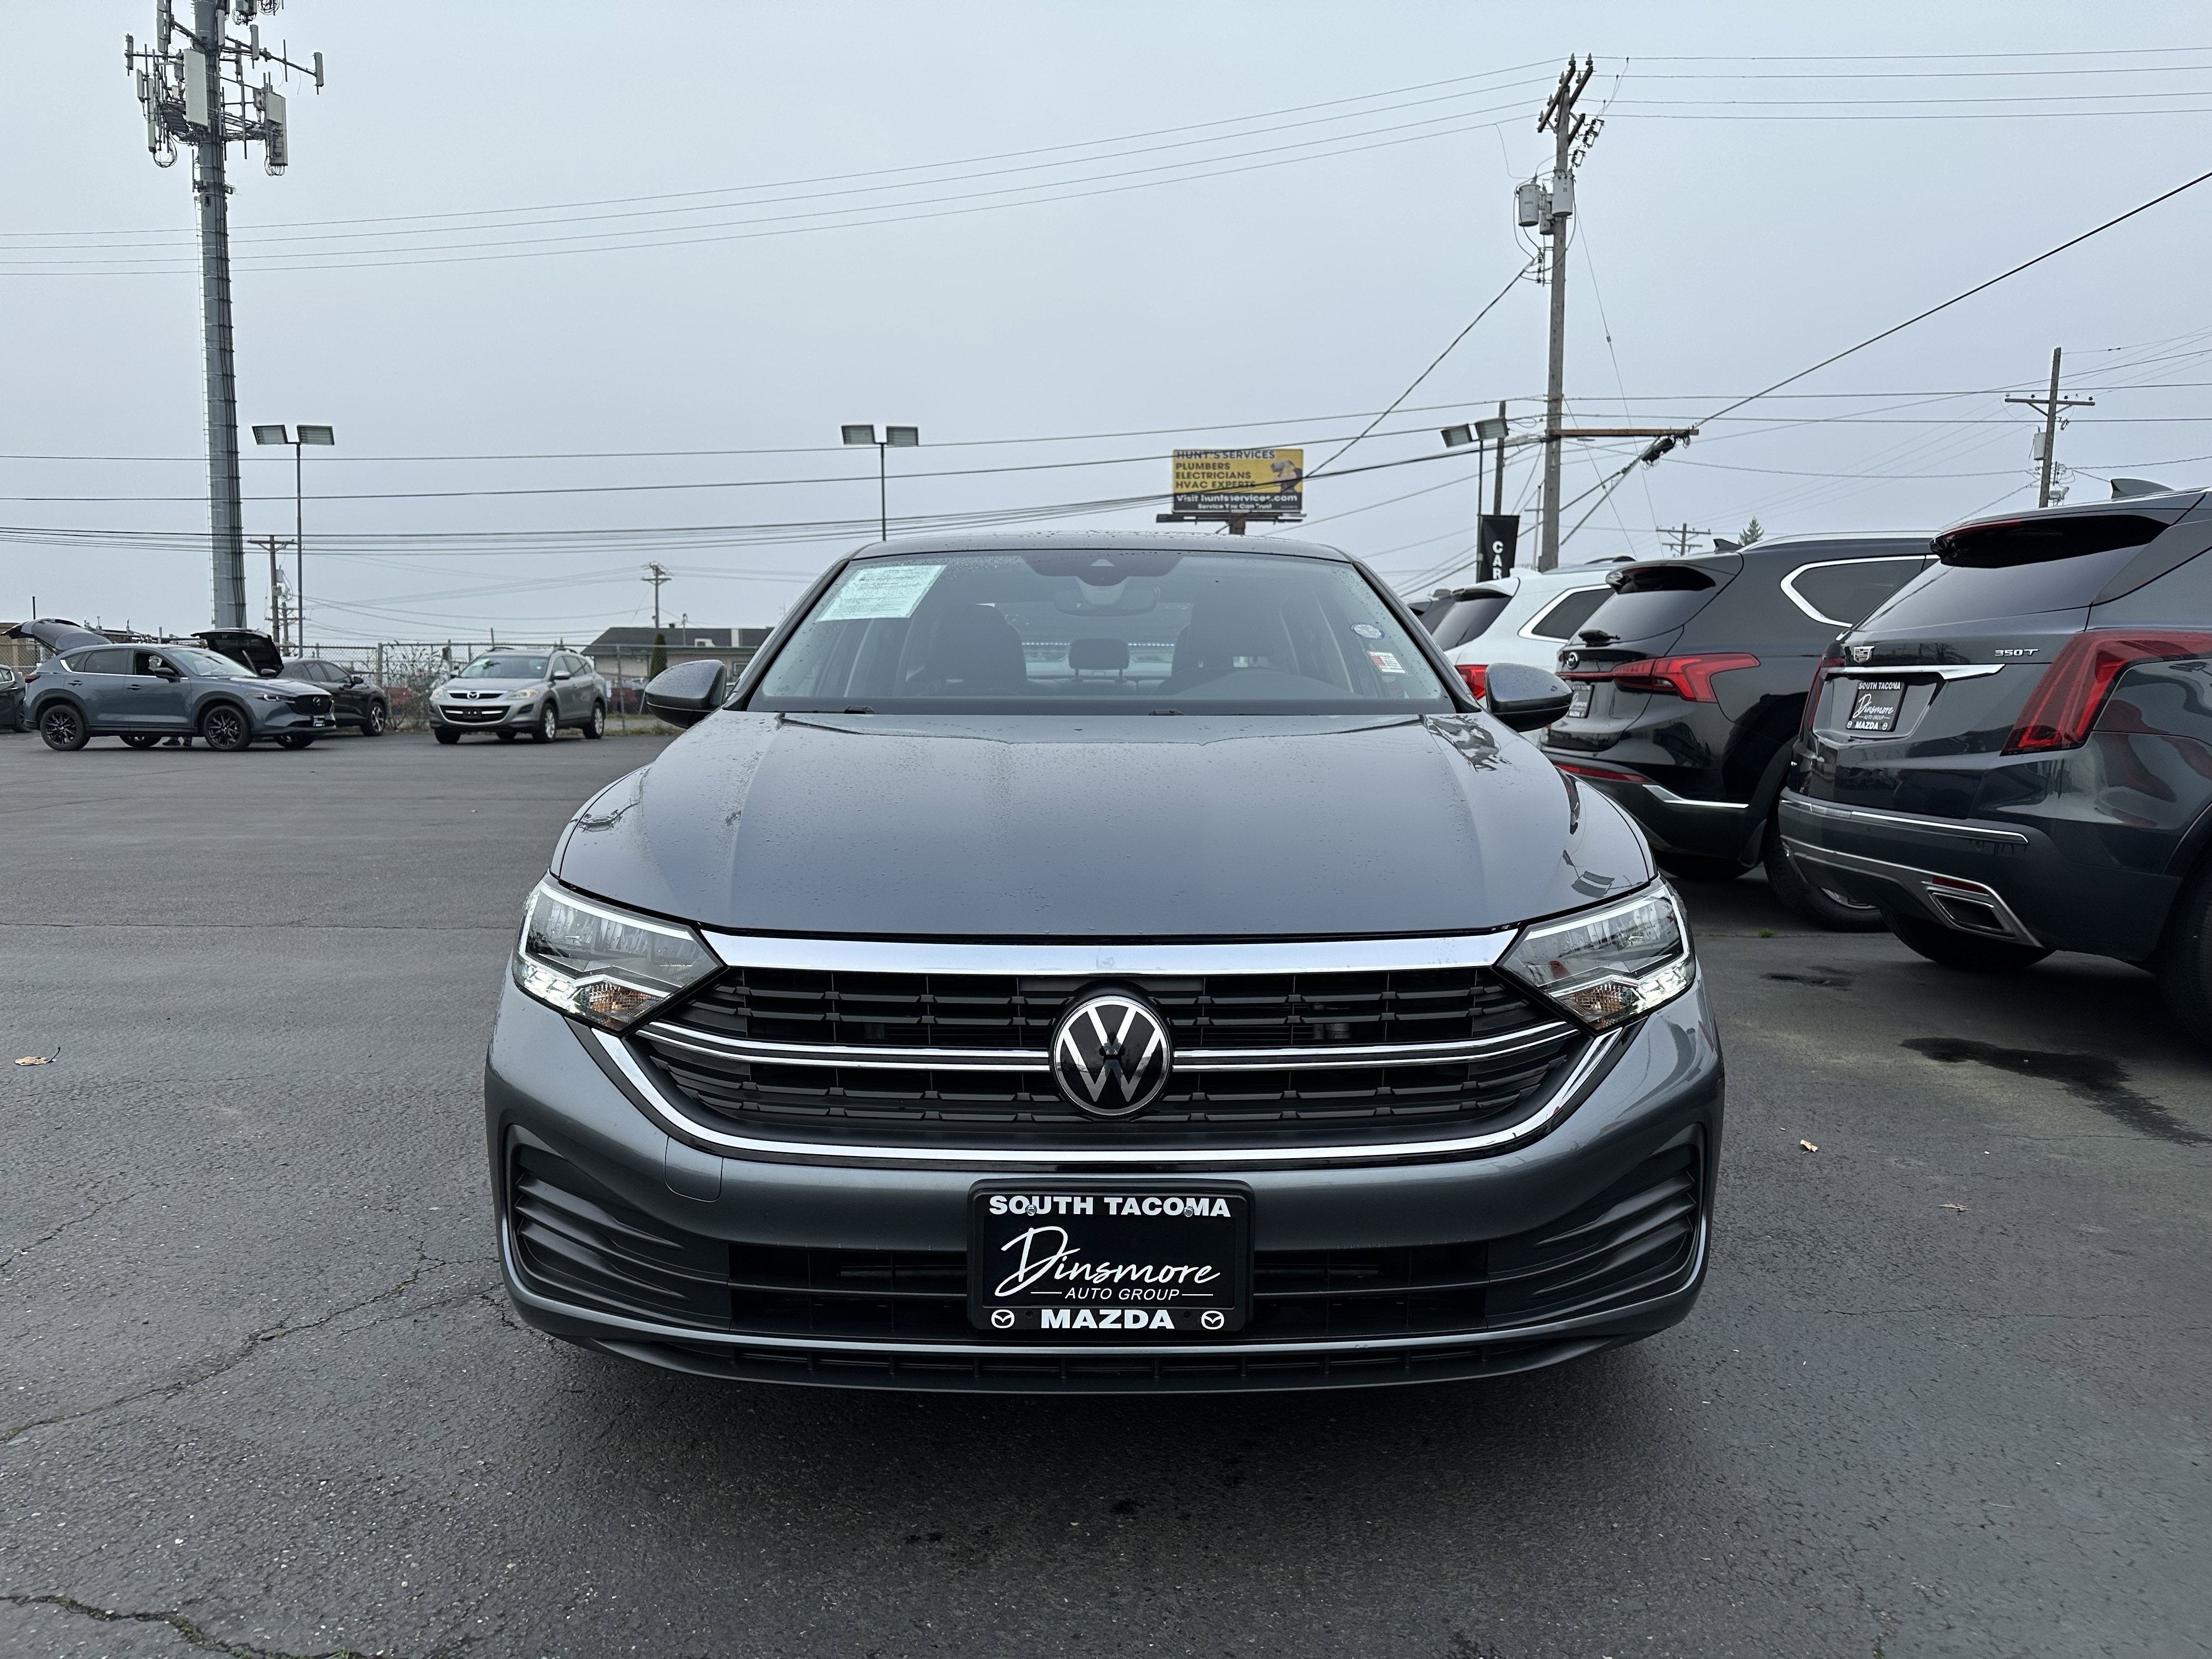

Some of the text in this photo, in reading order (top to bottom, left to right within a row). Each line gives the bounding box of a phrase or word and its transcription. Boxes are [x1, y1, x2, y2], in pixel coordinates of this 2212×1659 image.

[1222, 450, 1275, 459] SERVICES
[1852, 693, 1894, 718] Dinsmore
[1855, 721, 1878, 730] MAZDA
[989, 1195, 1231, 1217] SOUTH TACOMA
[994, 1226, 1221, 1297] Dinsmore
[1065, 1288, 1180, 1300] AUTO GROUP
[1041, 1309, 1175, 1329] MAZDA
